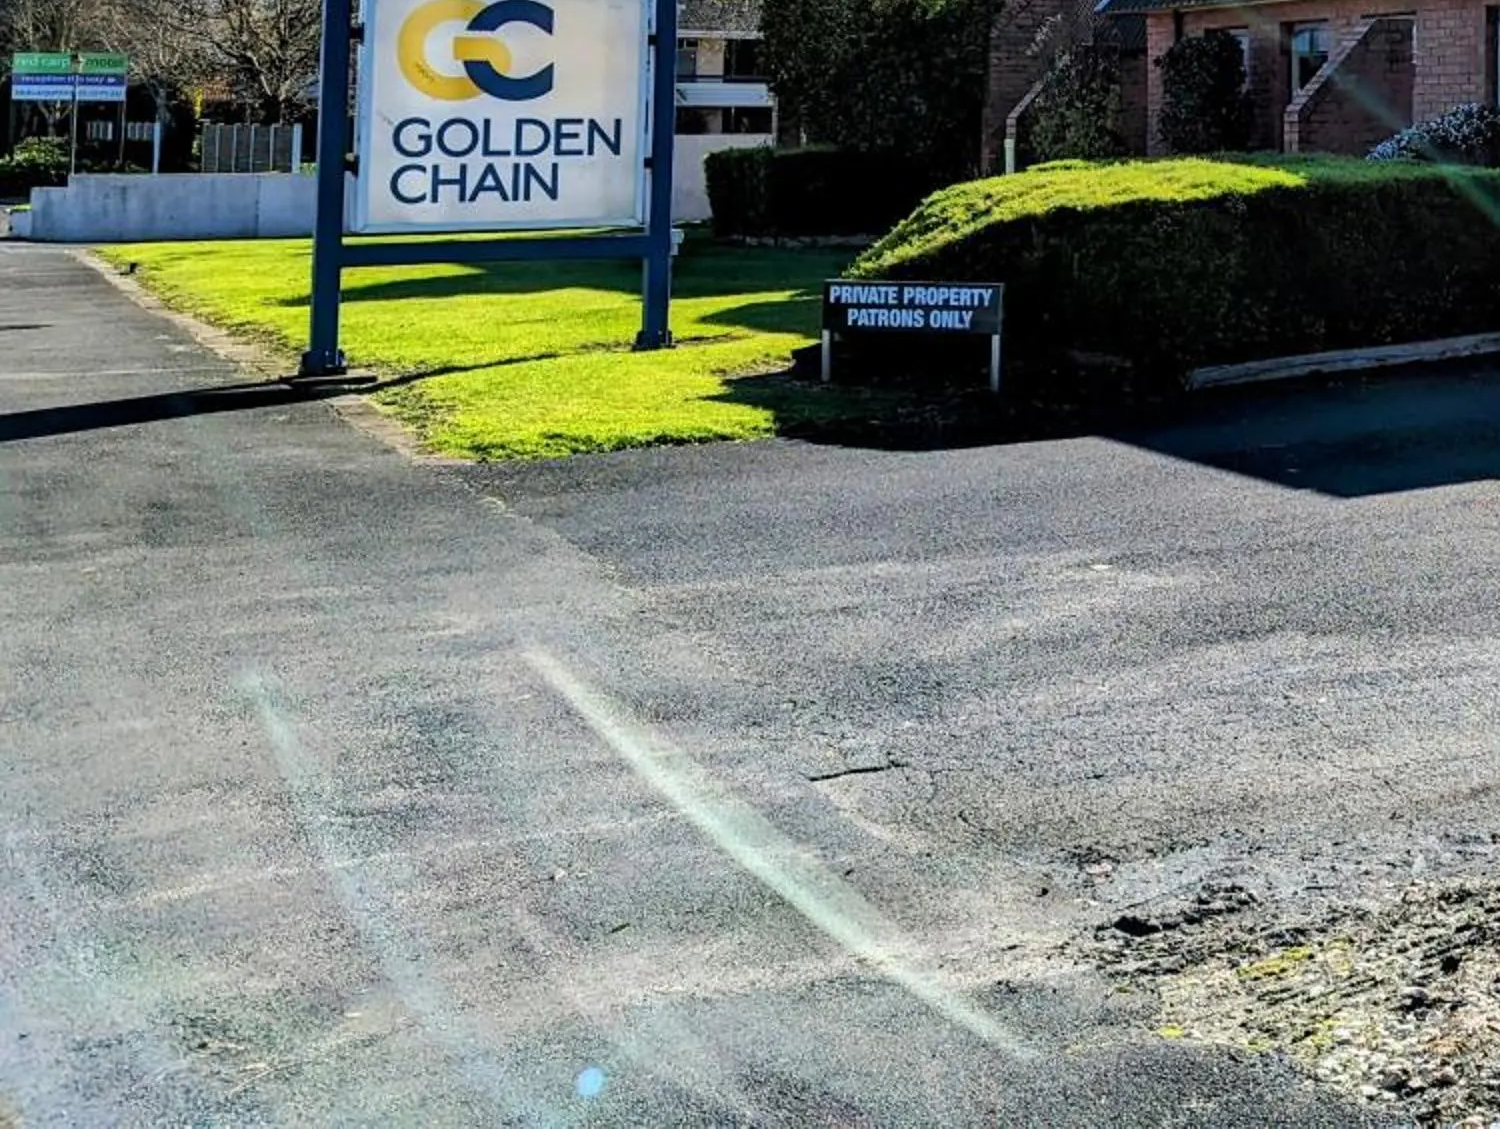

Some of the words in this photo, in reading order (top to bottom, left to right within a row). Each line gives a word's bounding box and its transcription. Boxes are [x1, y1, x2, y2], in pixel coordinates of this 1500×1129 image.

[392, 118, 621, 157] GOLDEN
[390, 163, 558, 204] CHAIN
[829, 285, 899, 304] PRIVATE
[903, 287, 992, 307] PROPERTY
[847, 308, 924, 328] PATRONS
[930, 310, 973, 328] ONLY
